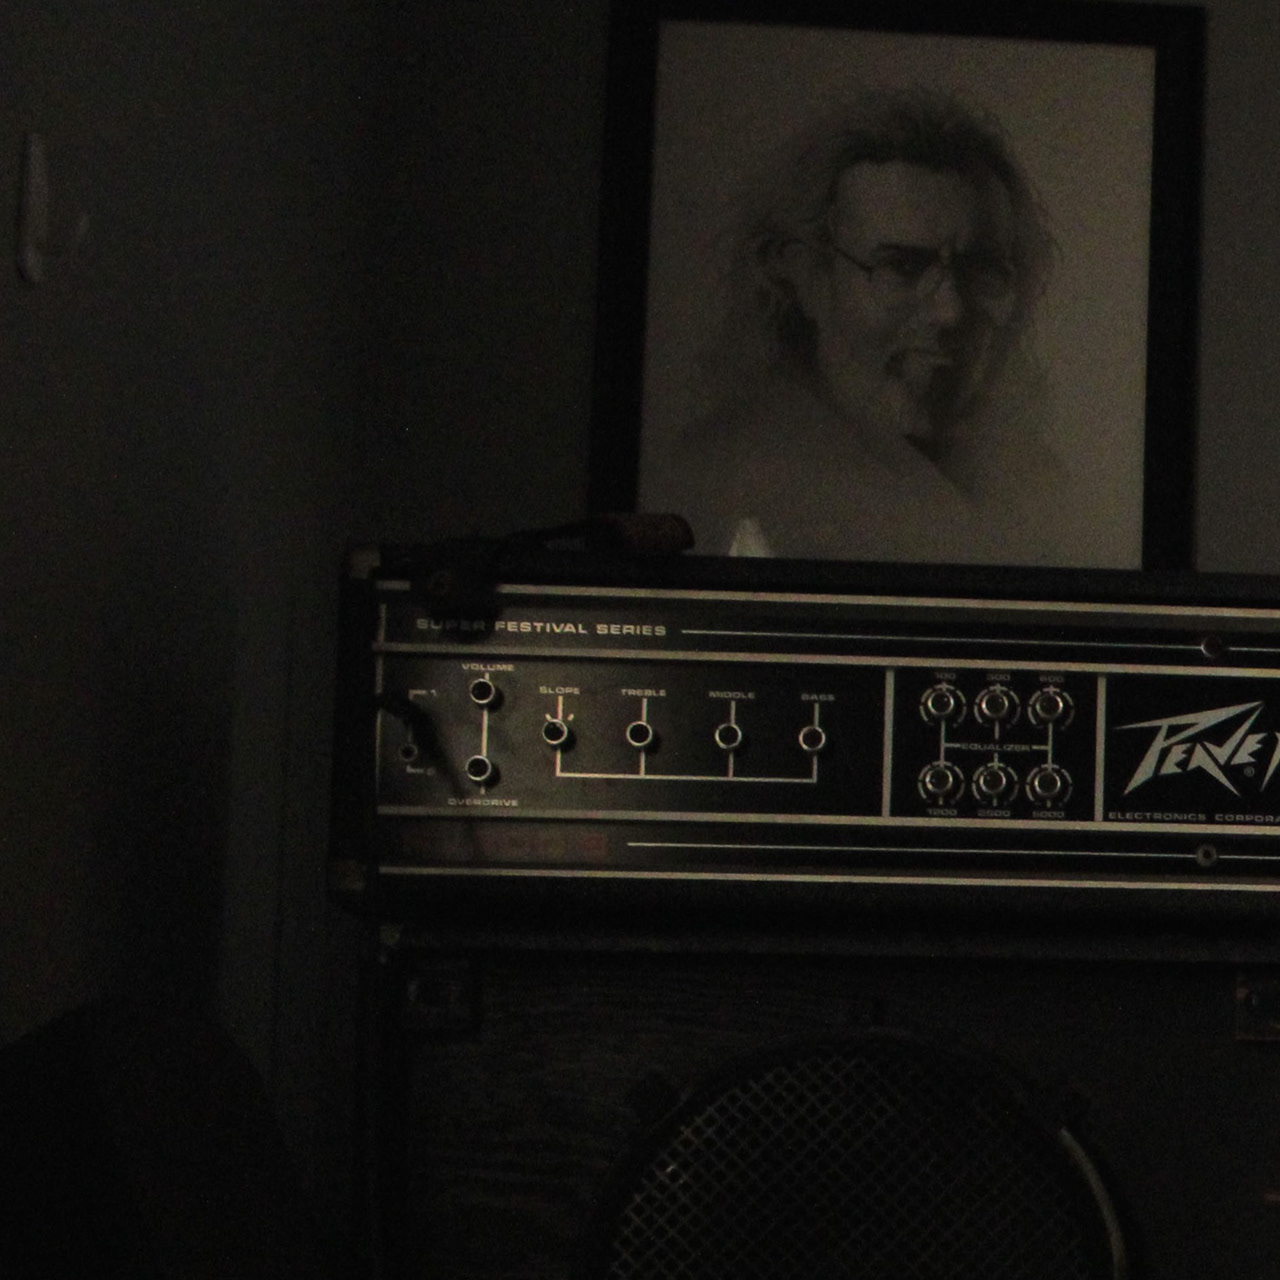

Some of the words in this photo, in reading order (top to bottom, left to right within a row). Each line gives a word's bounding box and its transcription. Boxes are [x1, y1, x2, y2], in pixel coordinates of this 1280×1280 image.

[494, 621, 588, 634] FESTIVAL
[596, 623, 667, 636] SERIES
[461, 662, 514, 671] VOLUME
[539, 685, 580, 695] SLOPE
[620, 688, 667, 697] TREBLE
[708, 690, 755, 699] MIDDLE
[961, 743, 1032, 752] EQUALIZER
[447, 798, 519, 808] OVERDRIVE
[1107, 812, 1207, 822] ELECTRONICS
